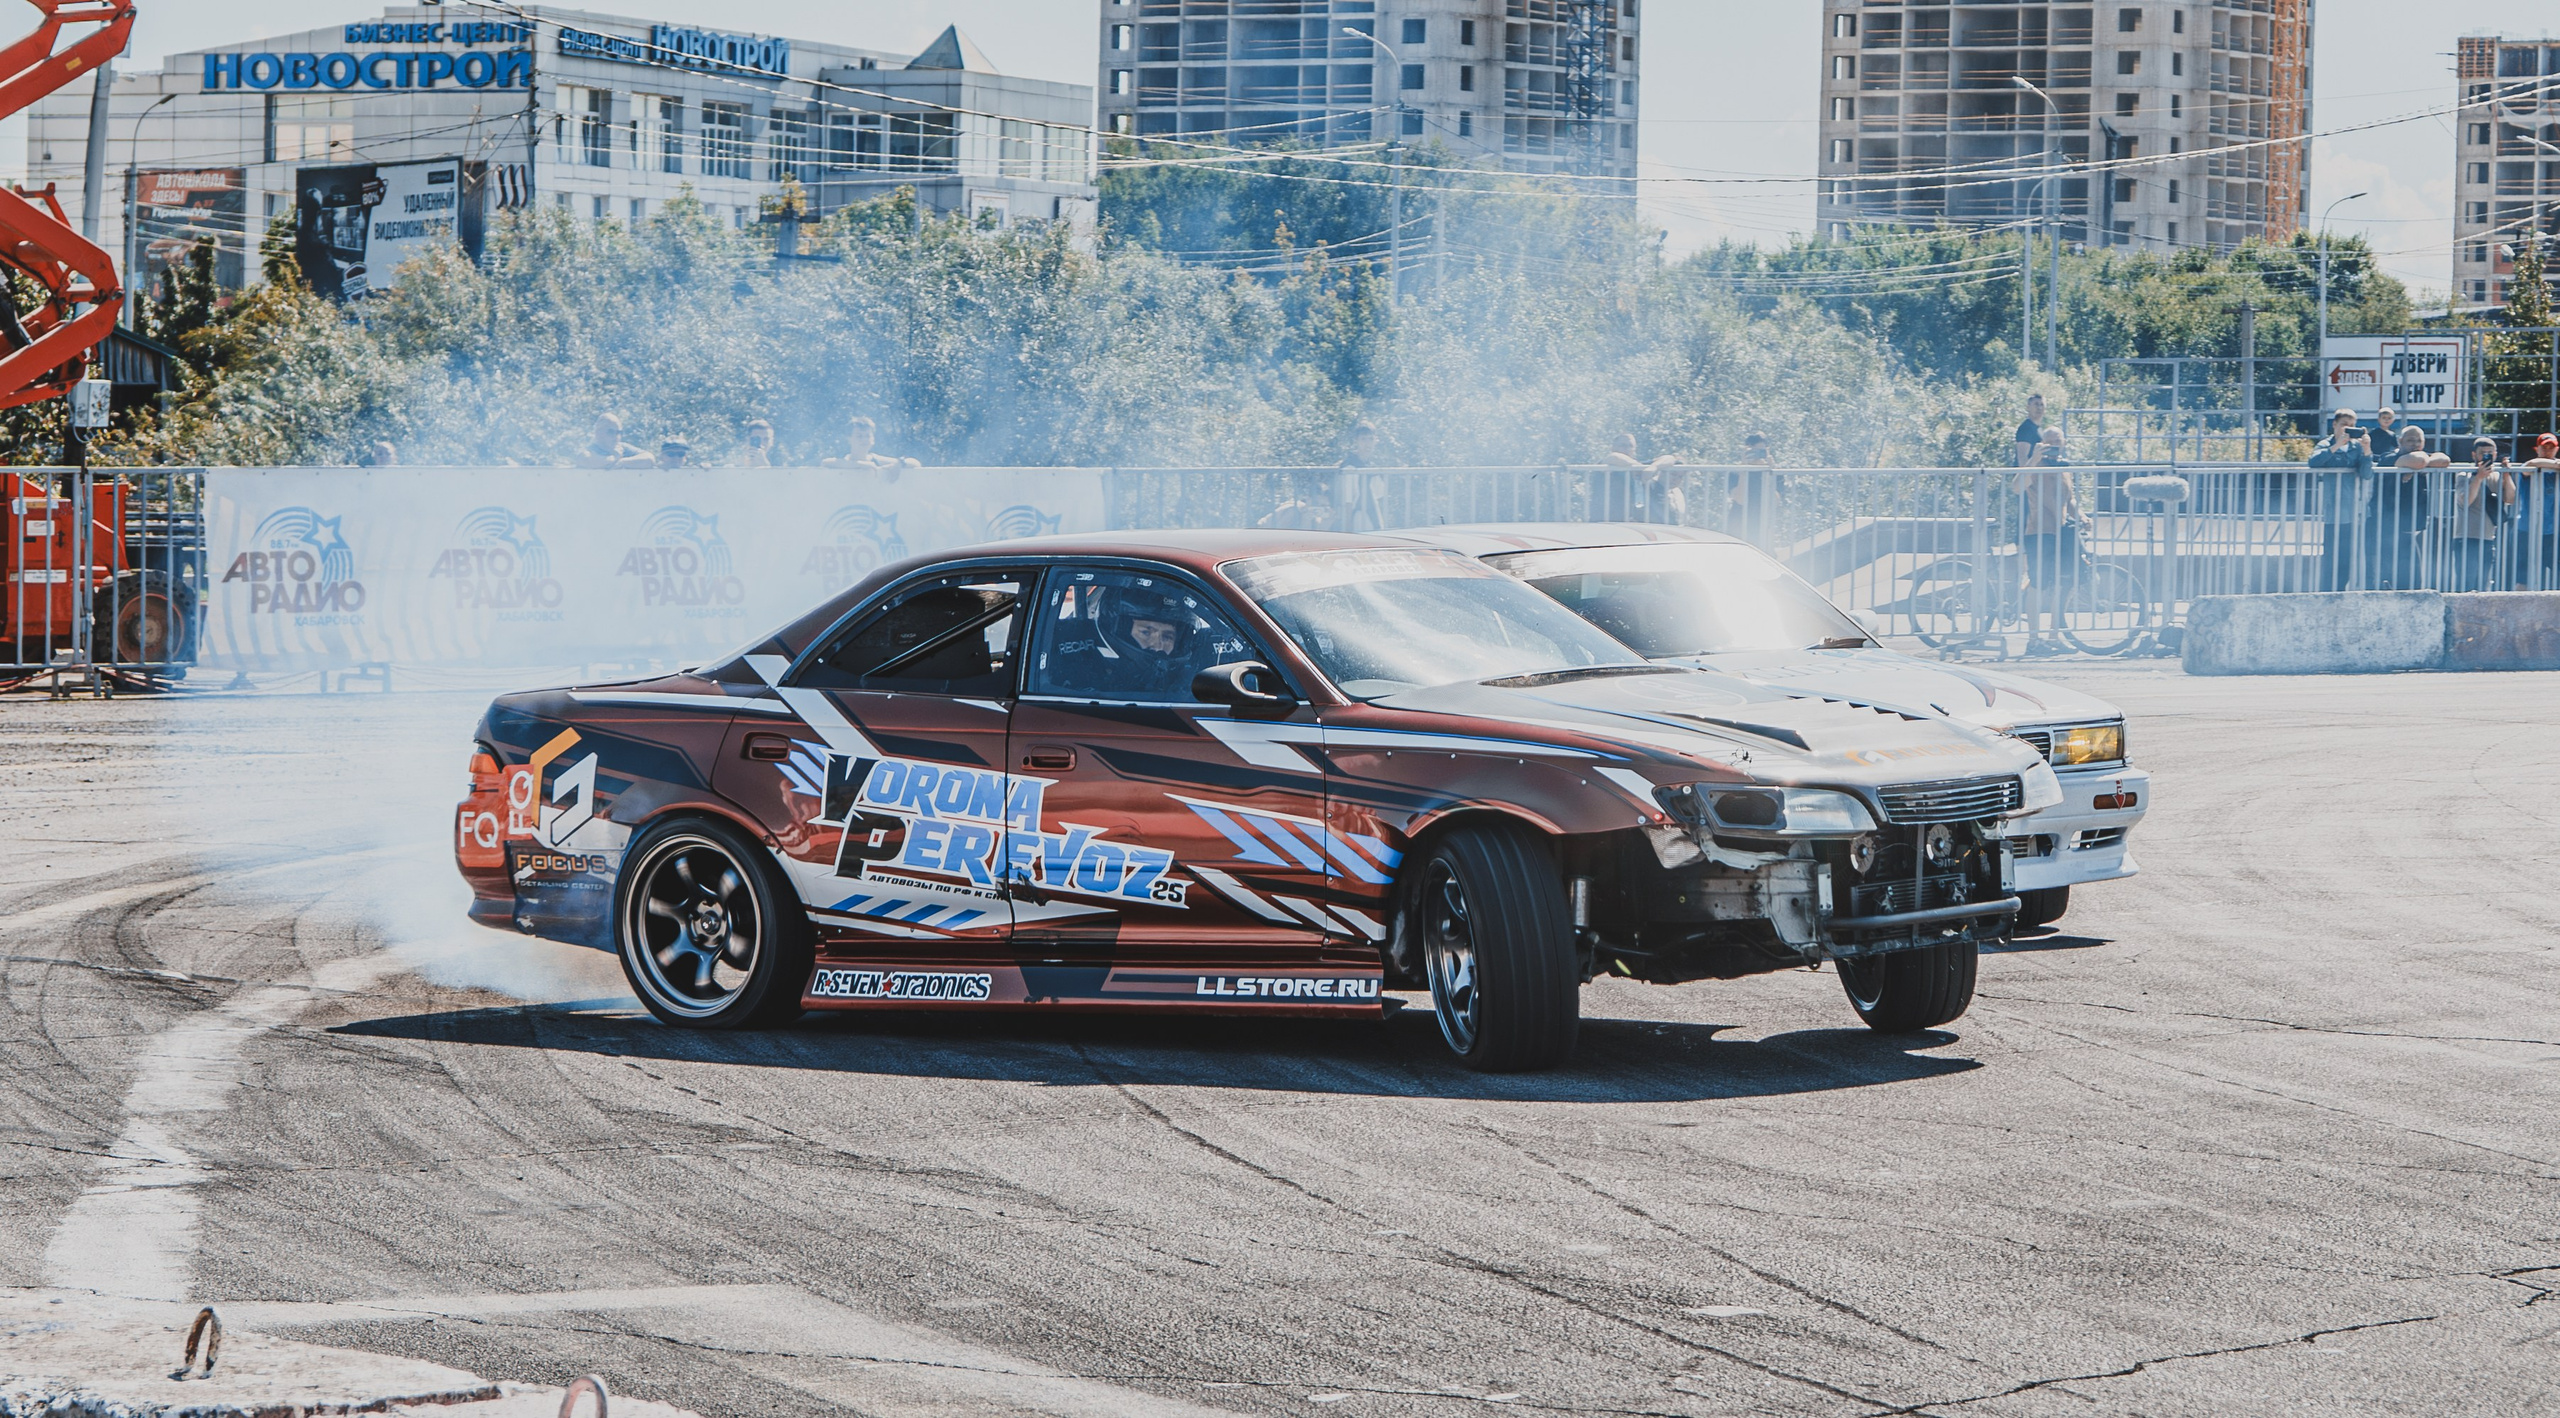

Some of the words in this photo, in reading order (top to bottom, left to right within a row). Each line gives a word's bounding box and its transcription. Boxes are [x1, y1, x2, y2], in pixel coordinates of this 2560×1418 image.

[345, 22, 536, 47] БИЗНЕС-ЦЕНТР
[650, 24, 790, 74] НОВОСТРОЙ
[203, 46, 531, 89] НОВОСТРОЙ
[156, 173, 226, 188] АВТОШКОЛА
[151, 190, 185, 203] ЗДЕСЬ!
[2338, 371, 2373, 384] ЗДЕСЬ
[2391, 353, 2447, 376] ДВЕРИ
[221, 550, 316, 583] АВТО
[428, 548, 514, 578] АВТО
[615, 546, 698, 576] АВТО
[799, 545, 877, 575] АВТО
[251, 580, 366, 614] РАДИО
[455, 577, 564, 609] РАДИО
[642, 576, 745, 606] РАДИО
[294, 615, 365, 627] ХАБАРОВСК
[821, 752, 1046, 833] VORONA
[460, 811, 498, 849] FQ
[517, 855, 606, 874] FOCUS
[834, 808, 1175, 900] PEREVOZ
[869, 875, 933, 891] АВТОВОЗЫ
[935, 885, 951, 893] ПО
[953, 887, 972, 896] РФ
[974, 890, 983, 898] И
[1197, 976, 1378, 998] LLSTORE.RU
